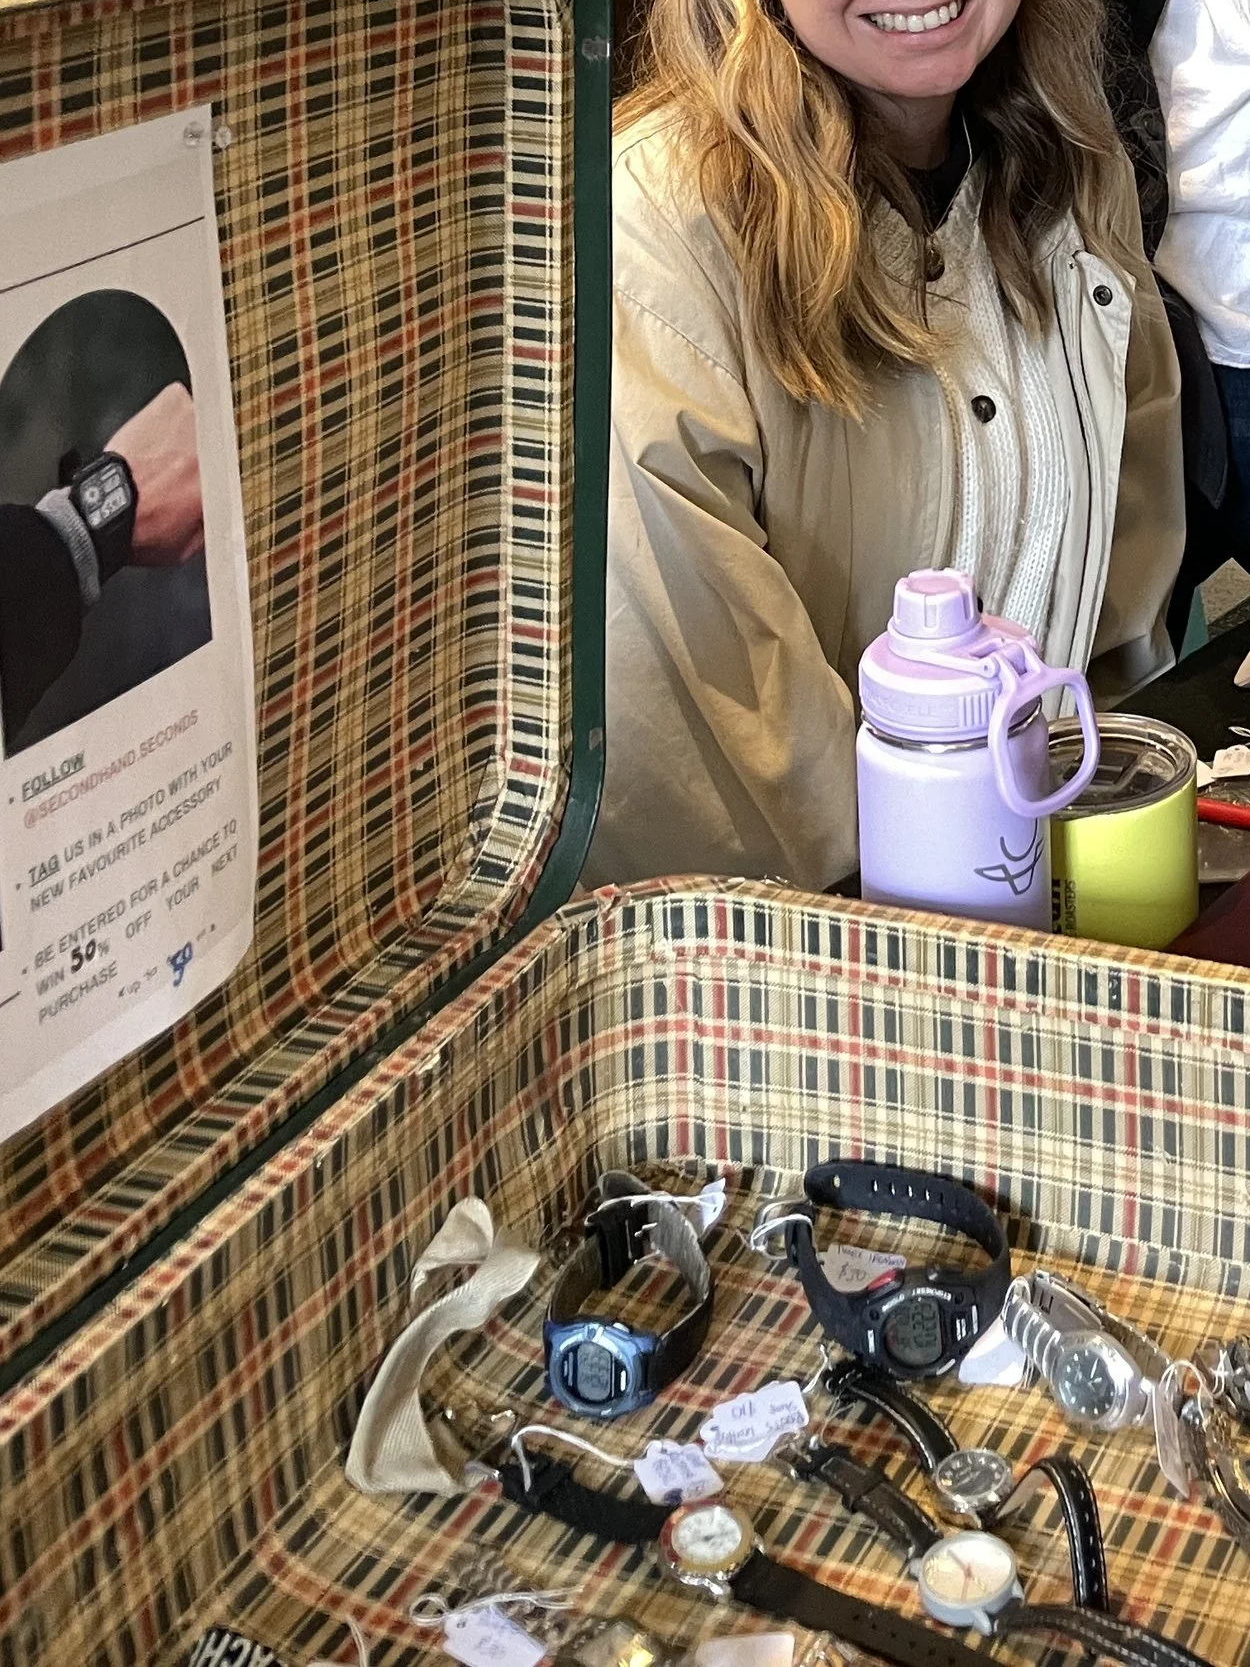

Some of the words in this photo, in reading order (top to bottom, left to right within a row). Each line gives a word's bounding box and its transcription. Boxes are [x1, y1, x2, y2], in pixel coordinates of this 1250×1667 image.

[22, 750, 86, 801] FOLLOW
[24, 710, 199, 829] @SECONDHAND.SECONDS
[28, 855, 60, 887] TAG
[64, 841, 84, 863] US
[88, 828, 103, 848] IN
[106, 820, 118, 838] A
[120, 789, 166, 830] PHOTO
[168, 765, 198, 797] WITH
[201, 741, 233, 773] YOUR
[30, 882, 65, 913] NEW
[68, 828, 147, 890] FAVOURITE
[150, 775, 222, 839] ACCESSORY
[34, 944, 57, 970] BE
[58, 899, 127, 954] ENTERED
[130, 877, 158, 909] FOR
[160, 871, 170, 888] A
[172, 833, 221, 879] CHANCE
[223, 818, 238, 840] TO
[36, 967, 66, 997] WIN
[125, 909, 153, 940] OFF
[165, 875, 200, 911] YOUR
[211, 842, 239, 877] NEXT
[38, 959, 119, 1026] PURCHASE
